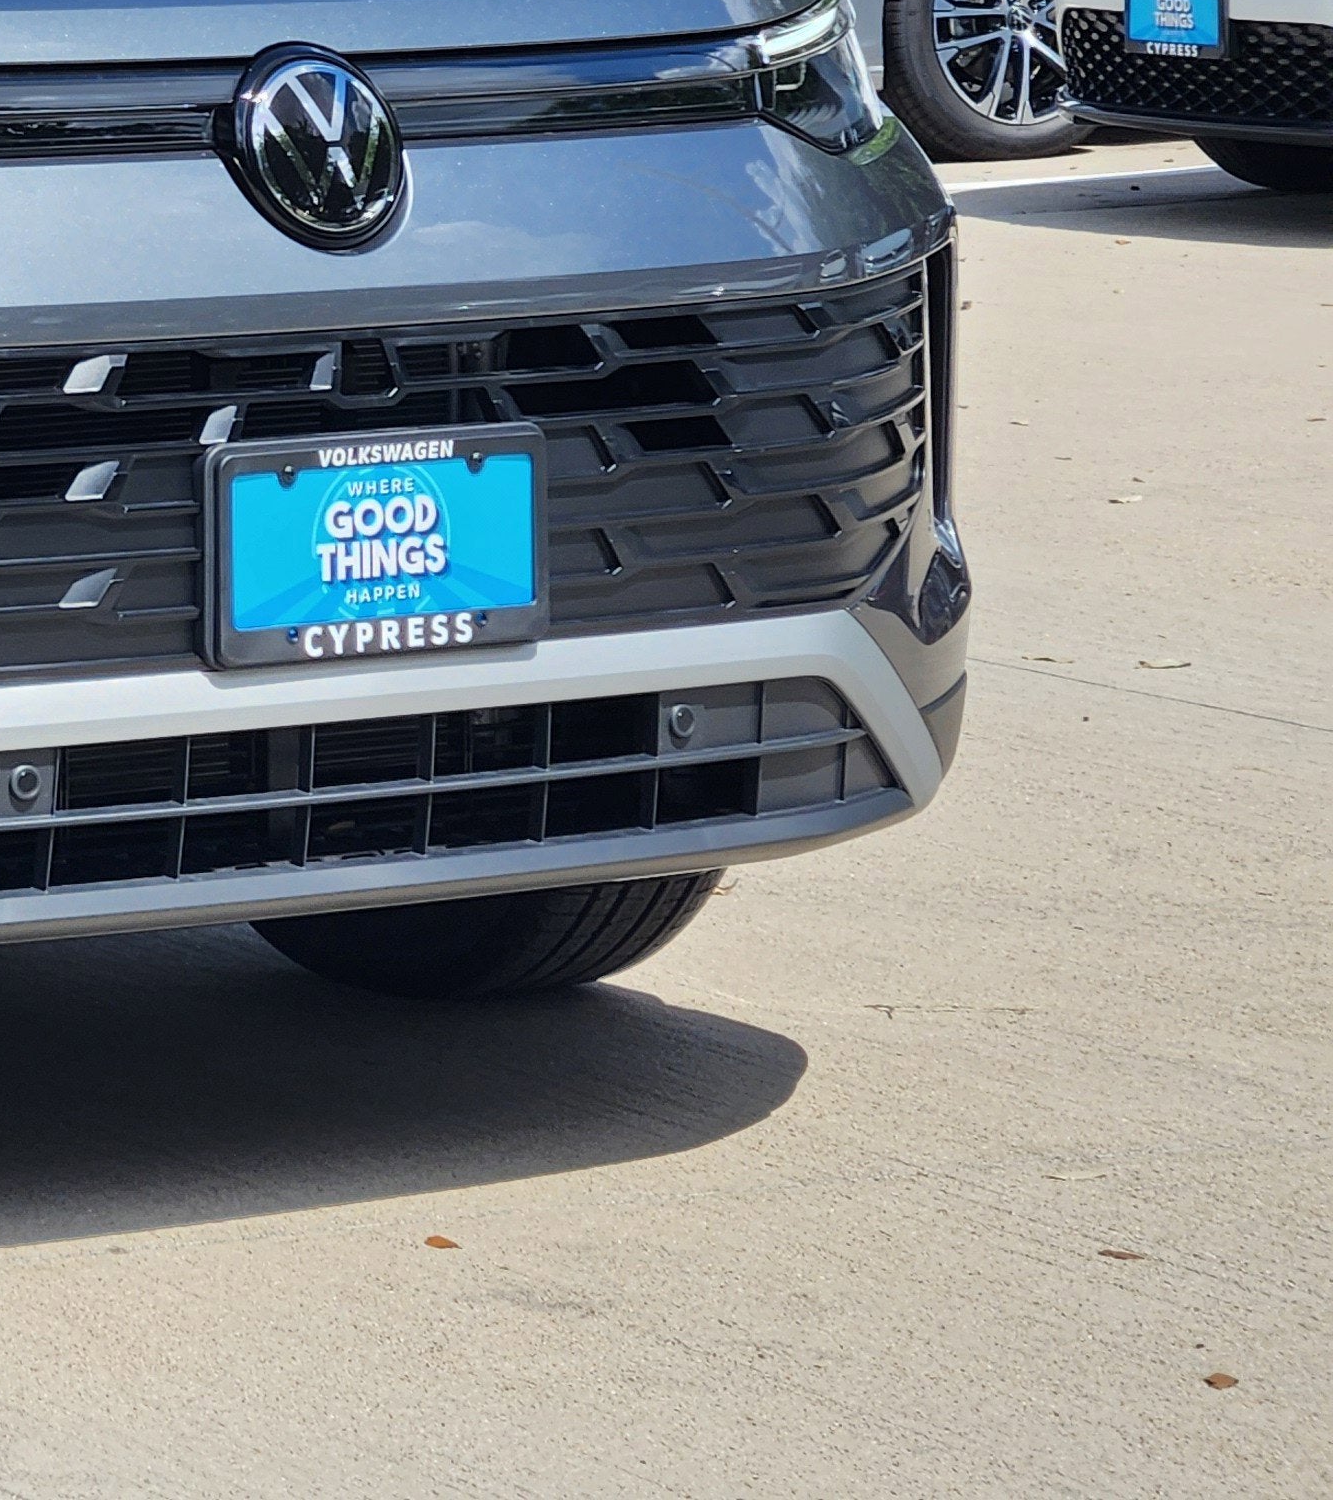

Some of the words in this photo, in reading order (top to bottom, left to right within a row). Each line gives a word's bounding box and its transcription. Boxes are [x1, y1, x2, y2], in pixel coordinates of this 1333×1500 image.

[1146, 42, 1198, 57] CYPRESS
[251, 59, 399, 232] VW
[318, 440, 454, 468] VOLKSWAGEN
[347, 477, 415, 497] WHERE
[324, 495, 438, 539] GOOD
[316, 534, 447, 582] THINGS
[344, 583, 421, 604] HAPPEN
[304, 612, 473, 658] CYPRESS
